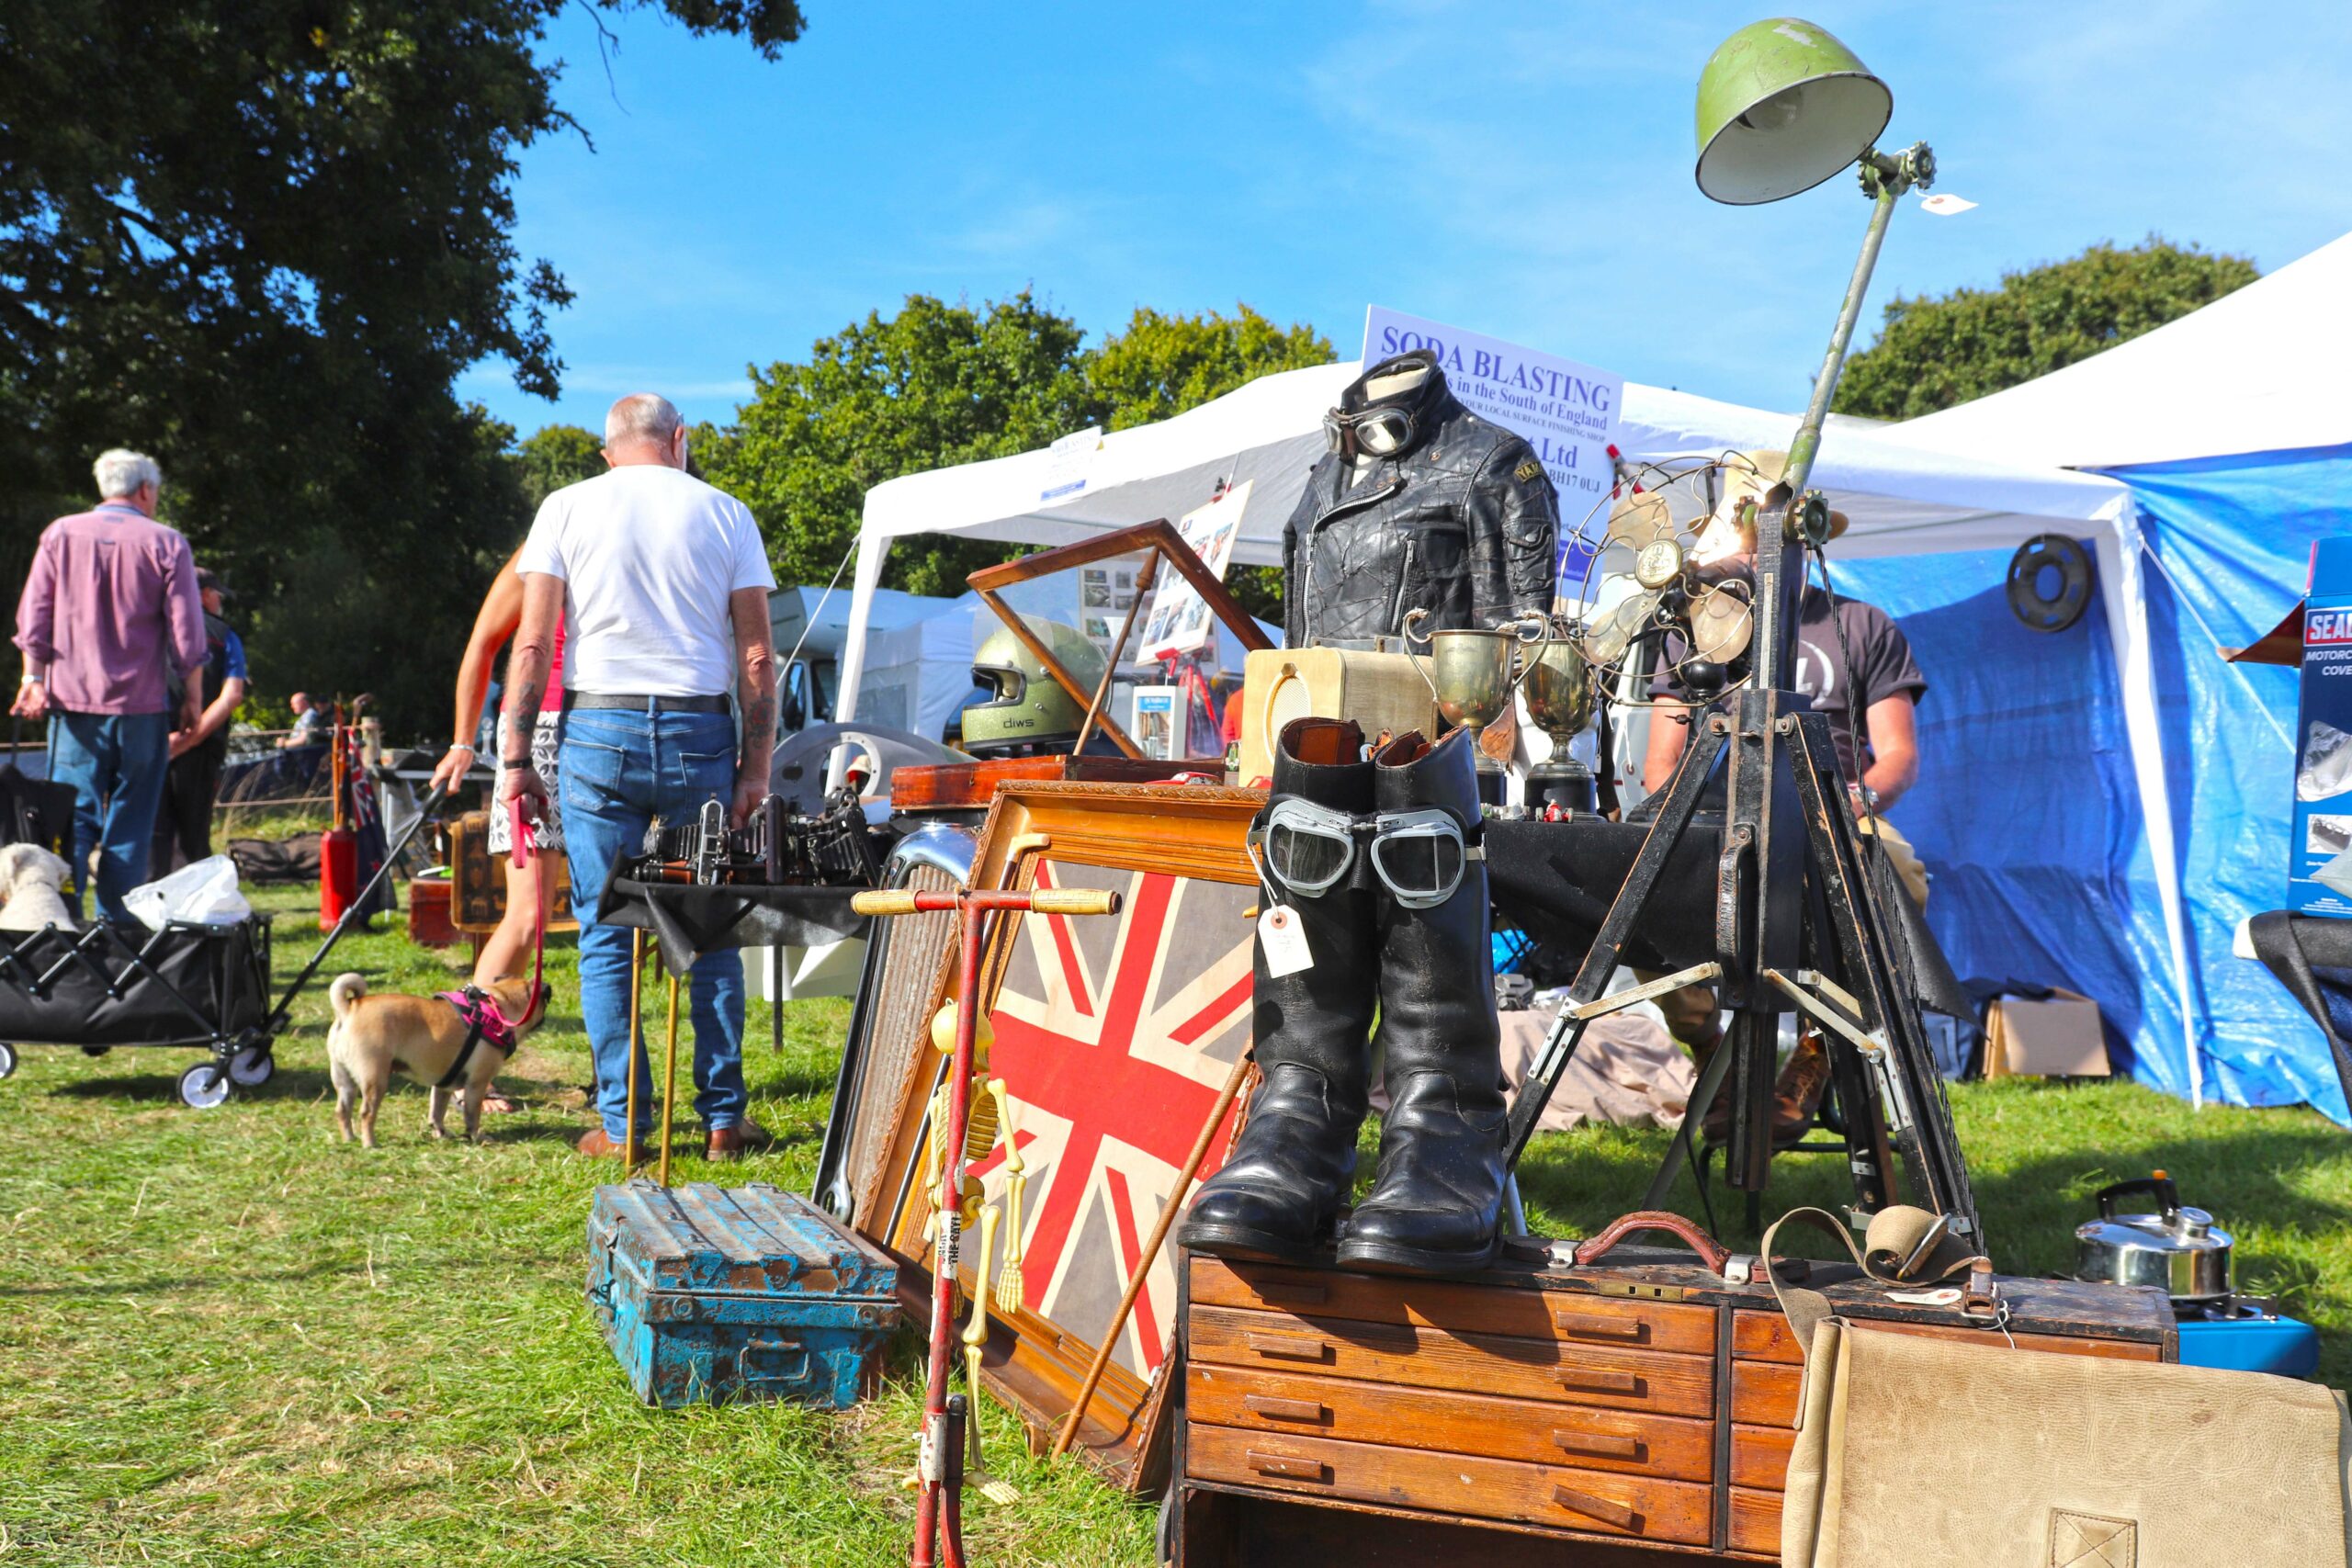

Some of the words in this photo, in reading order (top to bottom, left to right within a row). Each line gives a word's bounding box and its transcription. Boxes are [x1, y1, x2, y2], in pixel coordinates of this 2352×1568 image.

[1382, 326, 1464, 372] SODA
[1473, 349, 1610, 412] BLASTING
[1457, 376, 1470, 393] in
[1475, 381, 1496, 400] the
[1498, 388, 1537, 411] South
[1541, 400, 1555, 415] of
[1557, 402, 1607, 431] England
[1485, 404, 1511, 418] LOCAL
[1512, 410, 1547, 428] SURFACE
[1548, 420, 1586, 438] FINISHING
[1587, 431, 1606, 443] SHOP
[1541, 436, 1577, 468] Ltd
[1549, 468, 1577, 488] BH17
[1003, 717, 1035, 728] diws
